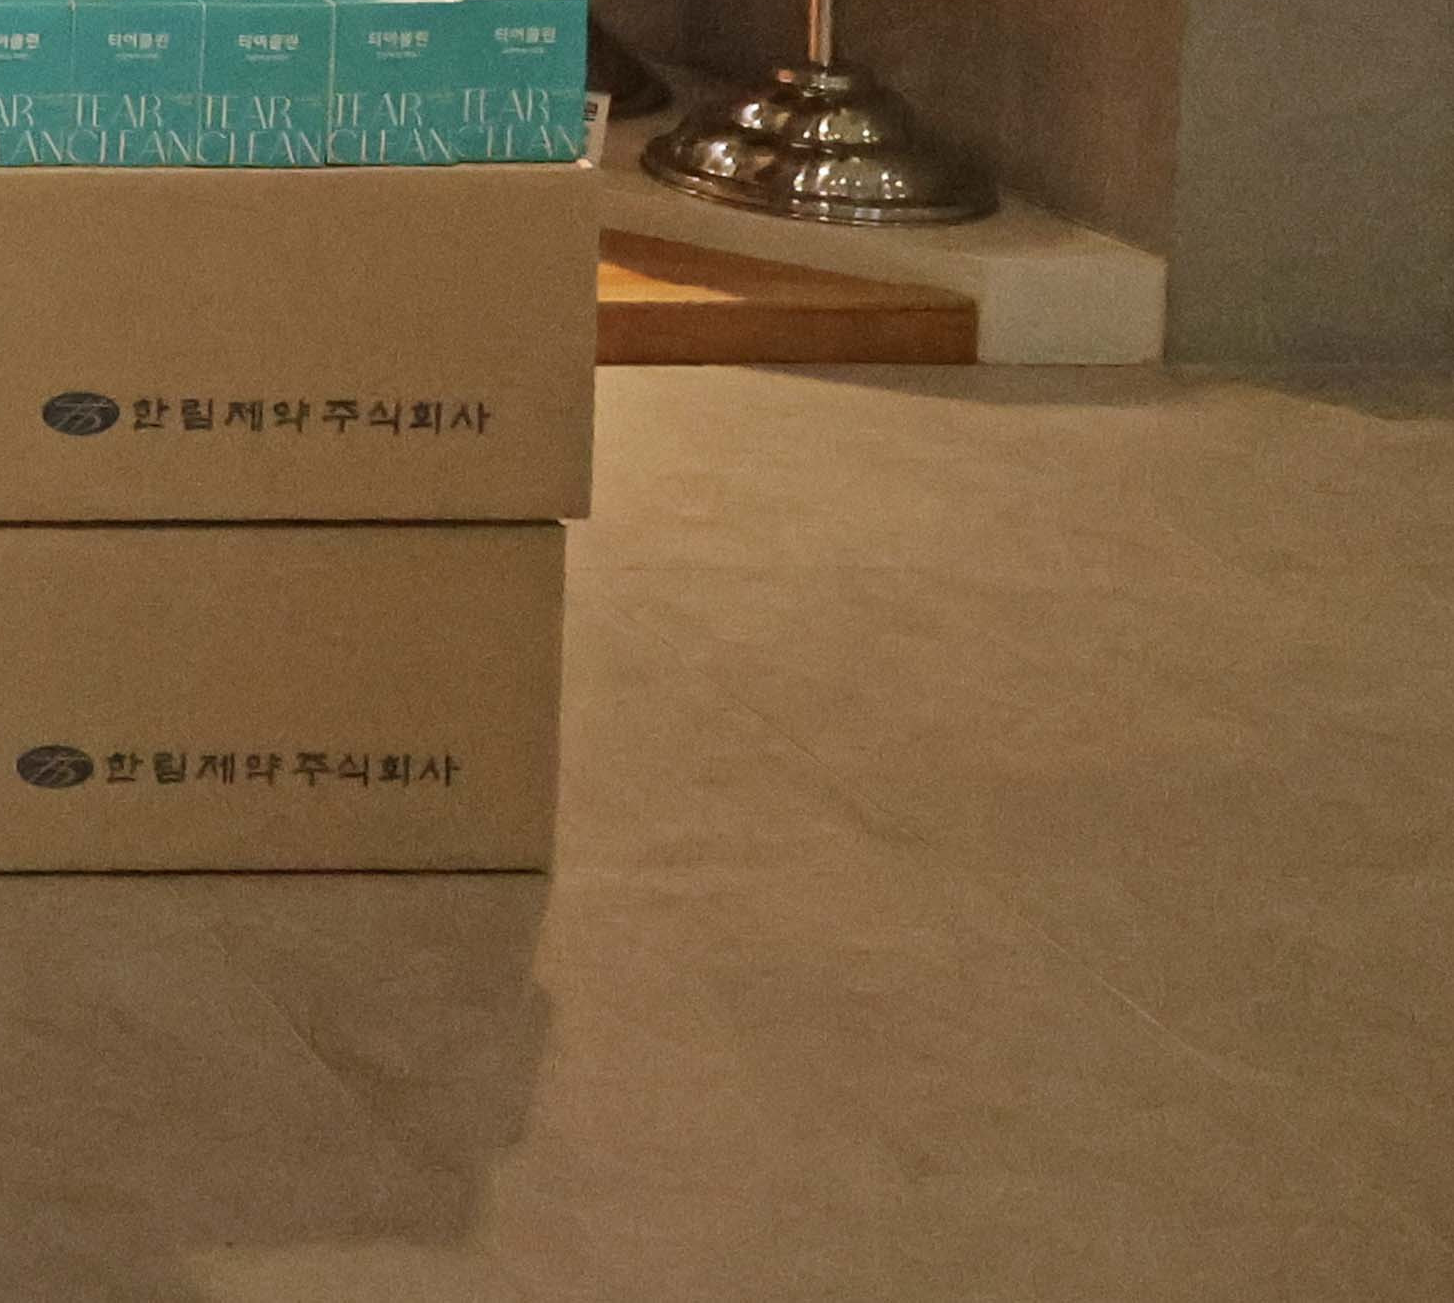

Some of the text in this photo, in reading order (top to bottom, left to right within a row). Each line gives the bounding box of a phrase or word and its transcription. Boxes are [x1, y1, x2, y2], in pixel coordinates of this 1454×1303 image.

[72, 94, 164, 128] TEAR
[202, 94, 293, 129] TEAR
[332, 92, 424, 127] TEAR
[460, 88, 550, 124] TEAR
